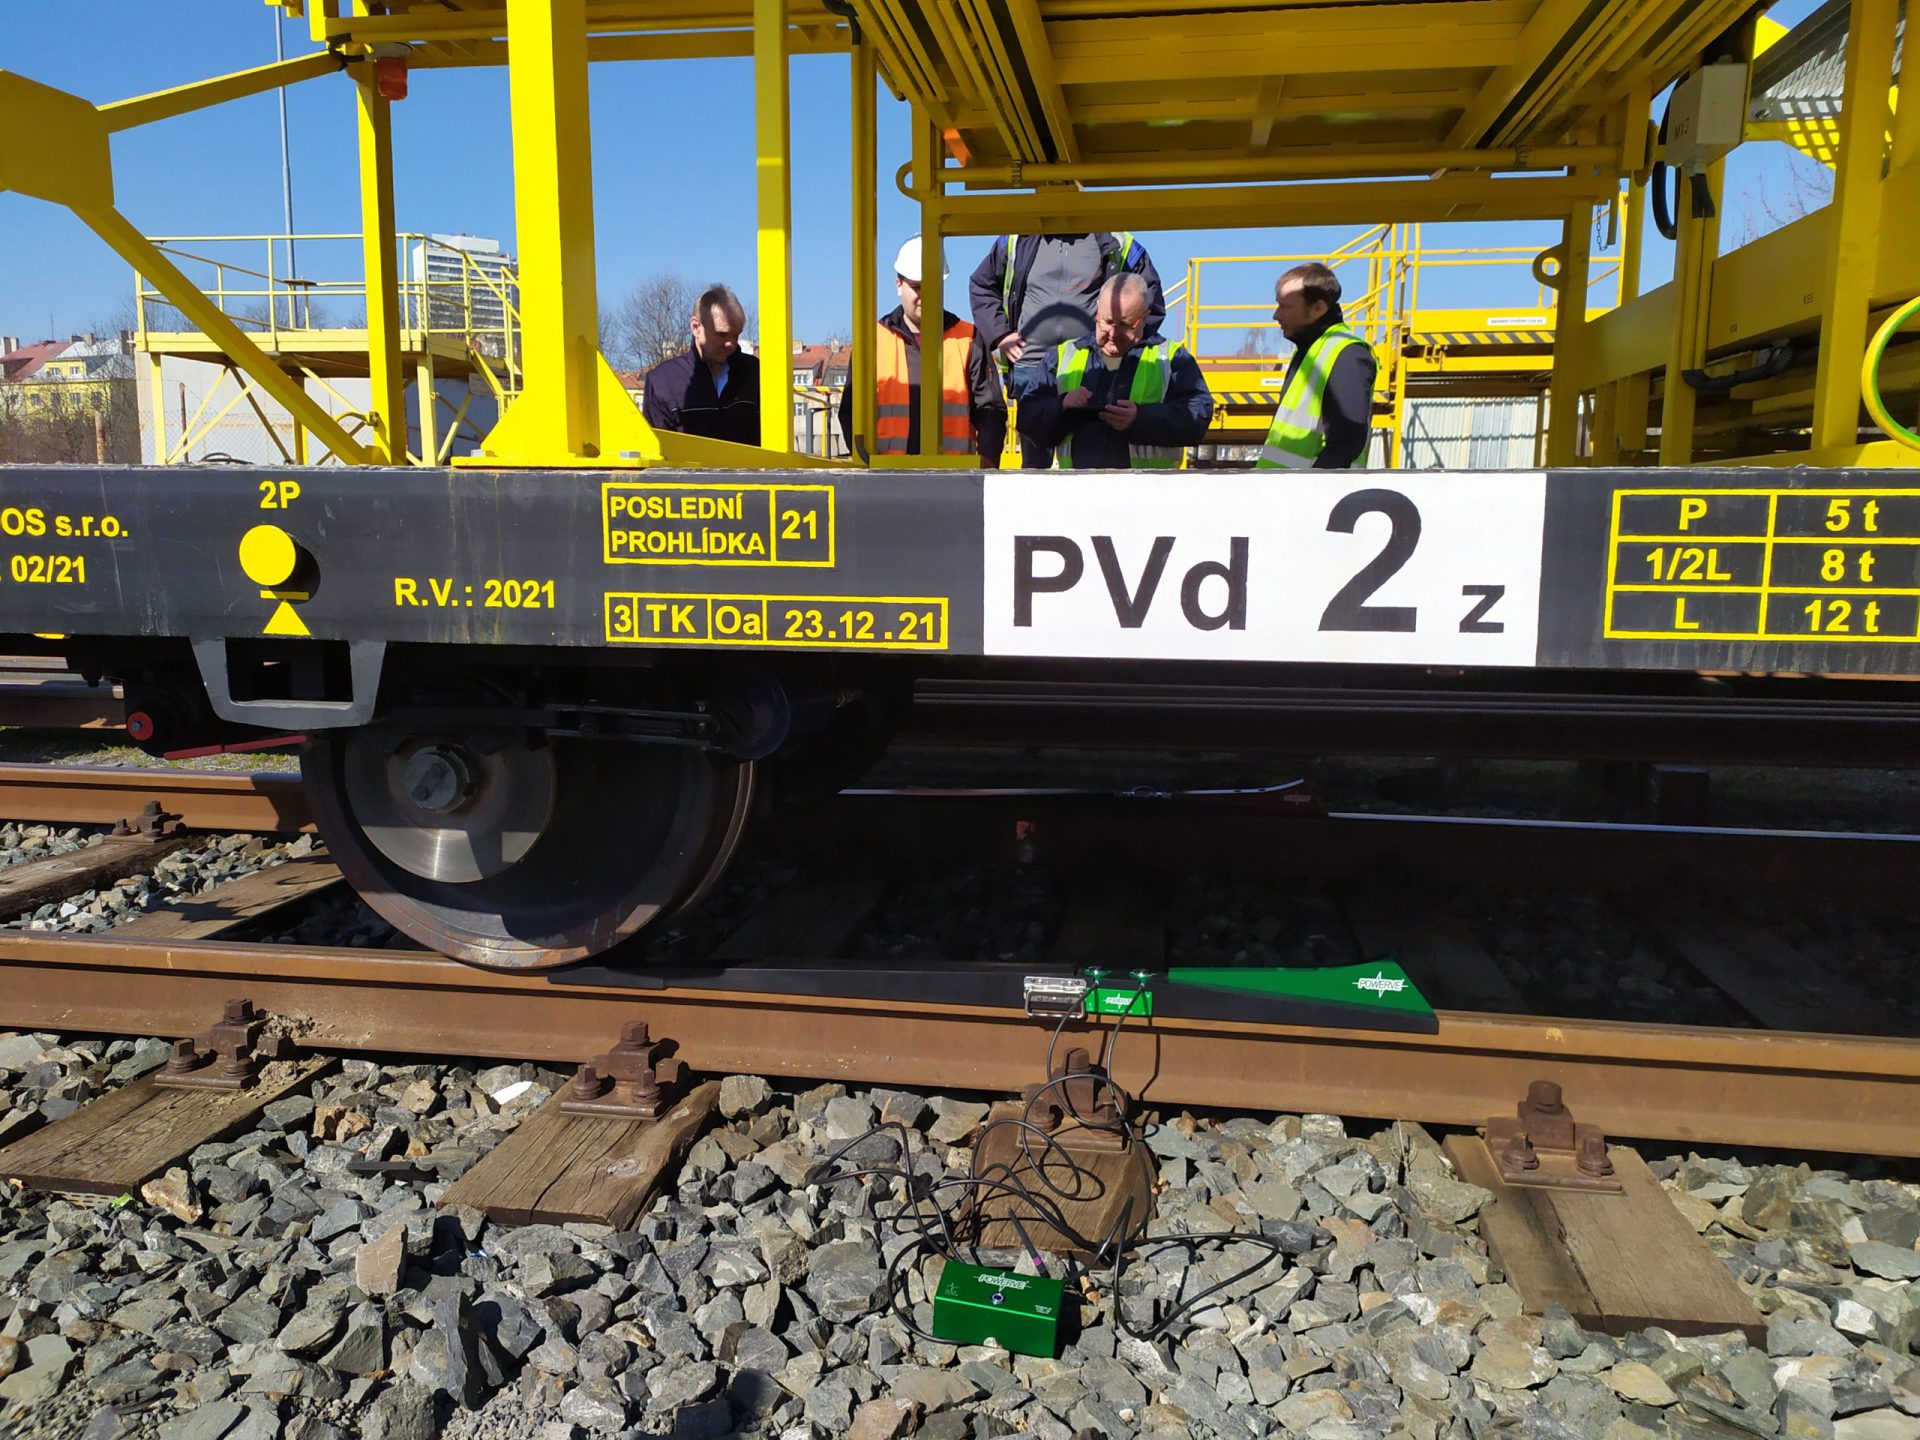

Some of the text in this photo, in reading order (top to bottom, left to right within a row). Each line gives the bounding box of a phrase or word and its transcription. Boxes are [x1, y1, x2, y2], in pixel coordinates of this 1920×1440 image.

[259, 481, 300, 509] 2P
[610, 493, 743, 519] POSLEDNÍ
[0, 508, 128, 537] OS s.r.o.
[781, 510, 818, 539] 21
[1679, 497, 1880, 531] P 5 t
[611, 527, 766, 555] PROHLÍDKA
[11, 554, 85, 583] 02/21
[1013, 488, 1505, 634] PVd 2 z
[1646, 547, 1876, 582] 1/2L 8 t
[484, 579, 555, 608] 2021
[613, 604, 632, 633] 3
[645, 603, 697, 634] TK
[714, 605, 761, 636] Oa
[1675, 598, 1881, 633] L 12 t
[1358, 977, 1403, 992] POWERVE
[978, 1273, 1027, 1290] POWERVE
